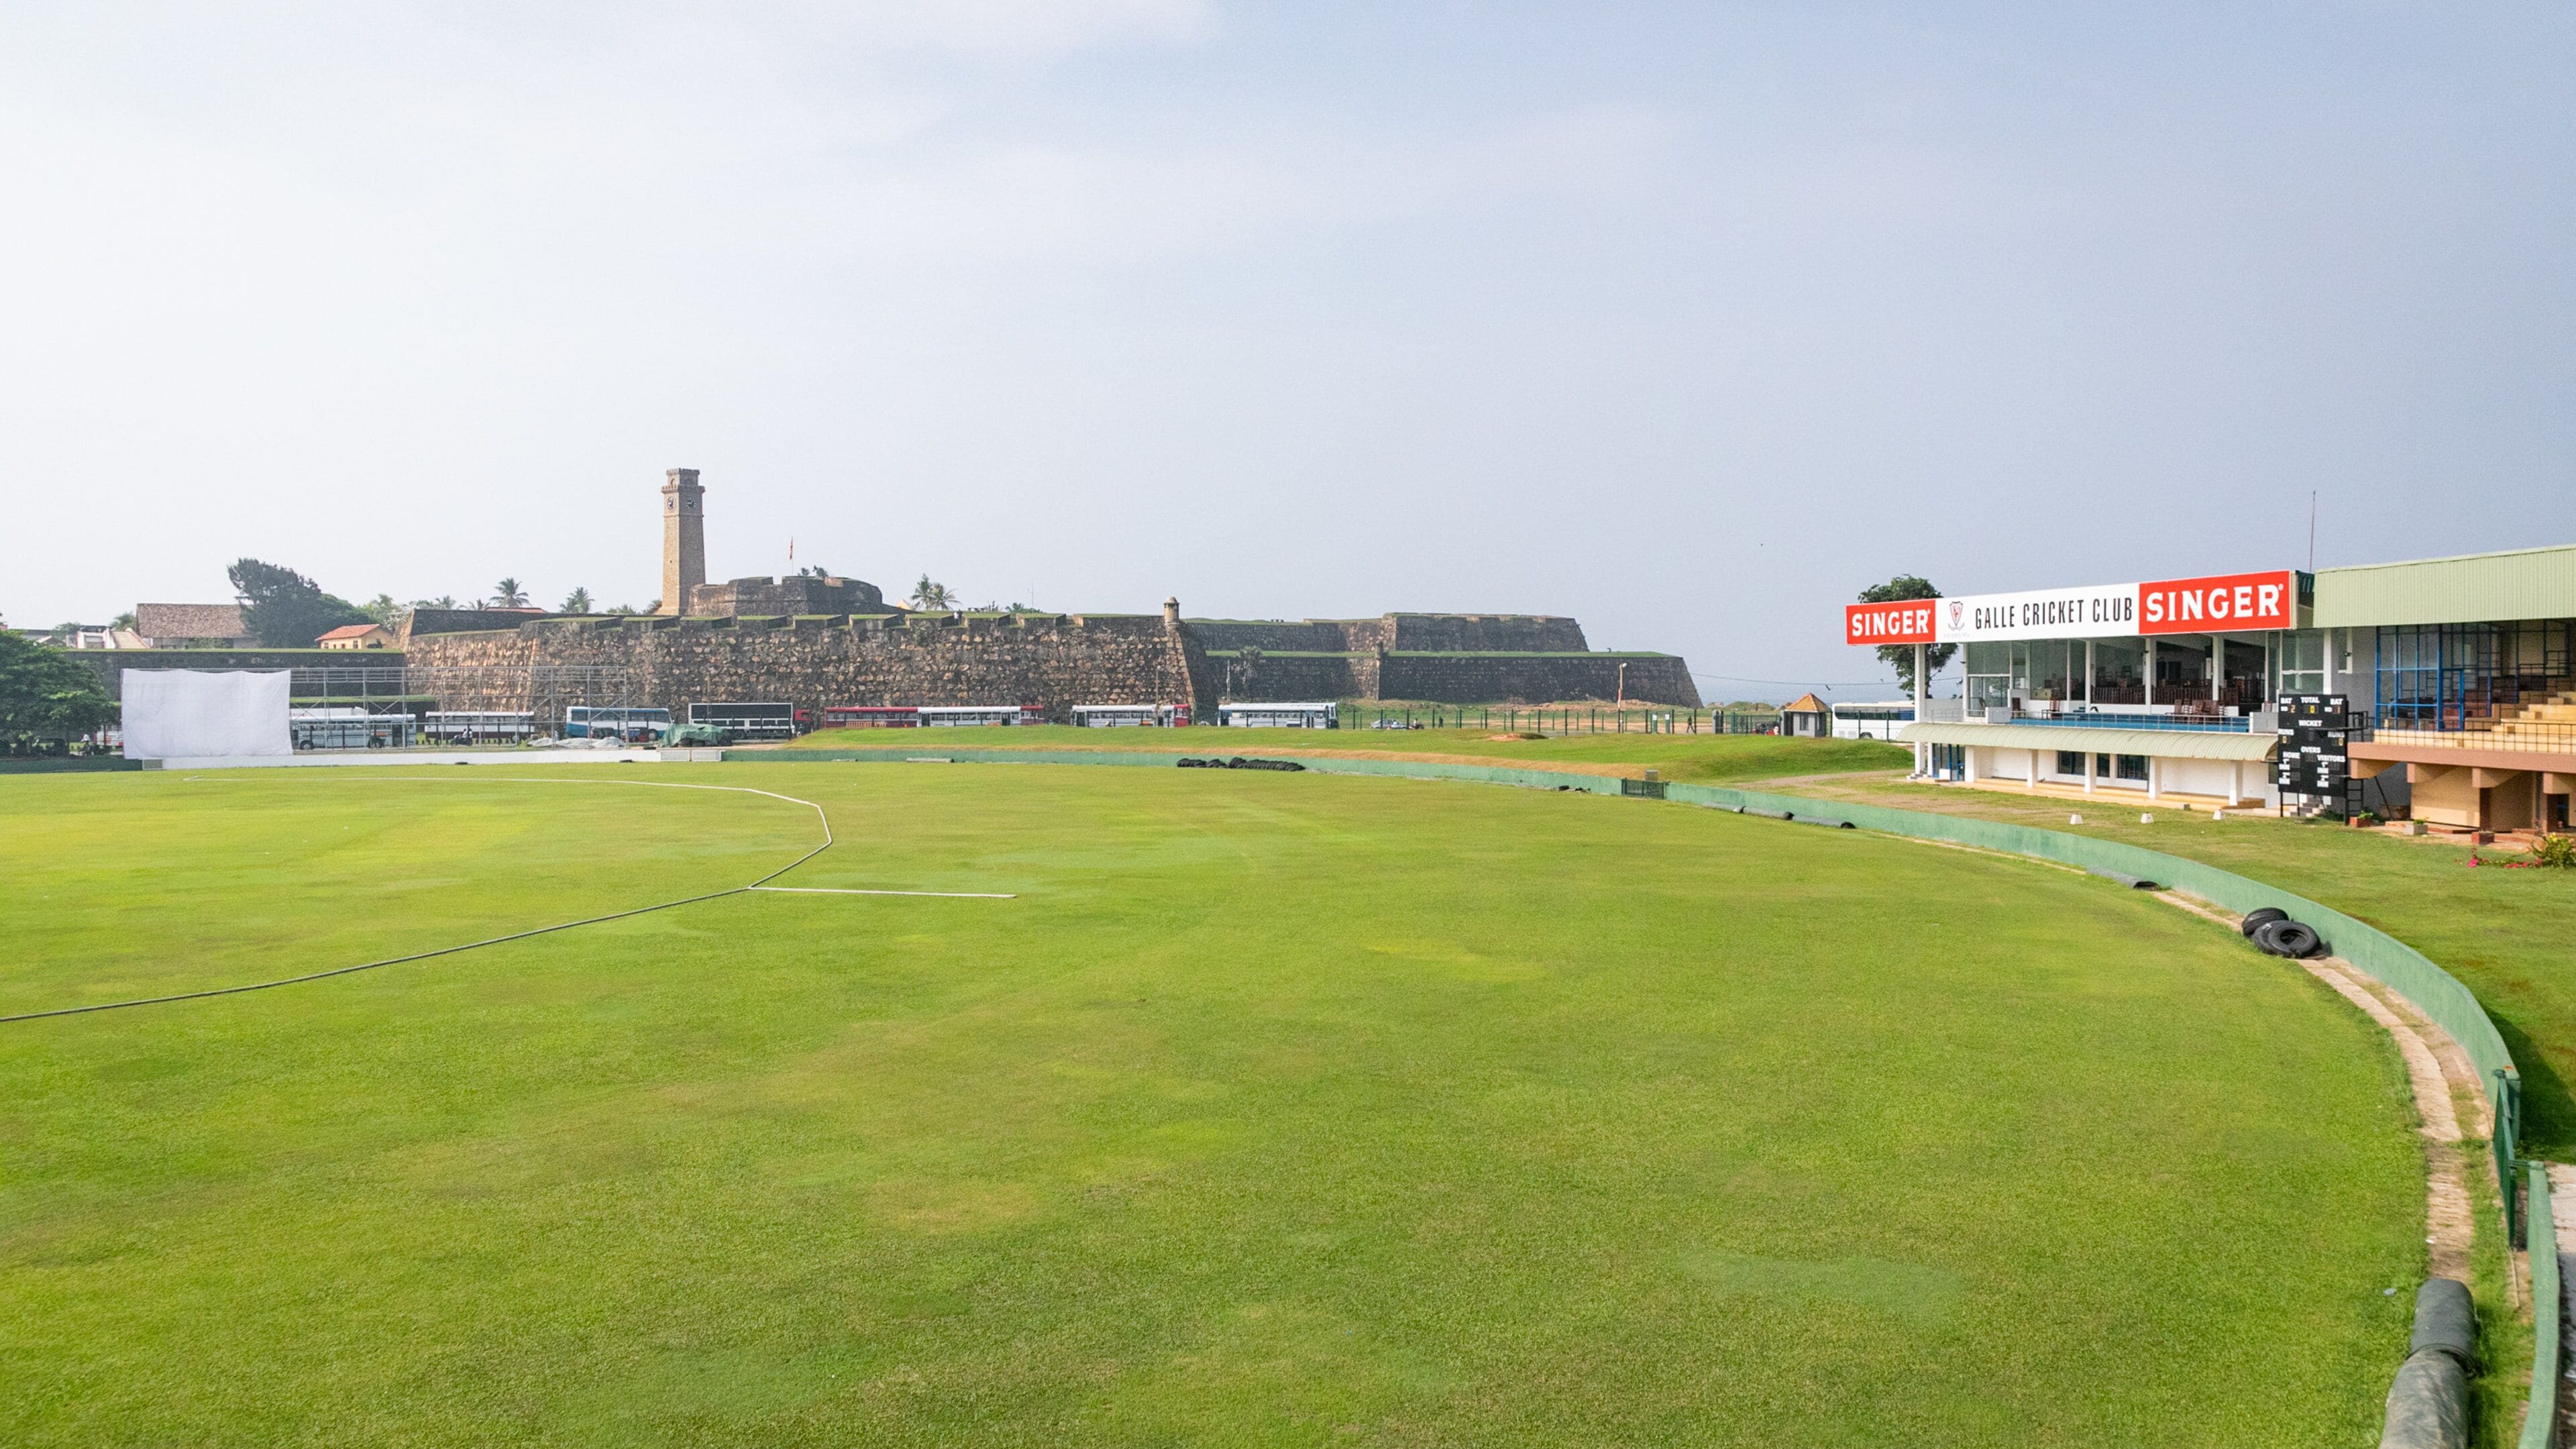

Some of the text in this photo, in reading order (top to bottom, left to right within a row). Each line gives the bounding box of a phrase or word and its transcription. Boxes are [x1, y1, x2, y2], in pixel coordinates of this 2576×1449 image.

[1975, 597, 2133, 629] GALLE CRICKET CLUB
[2146, 584, 2281, 623] SINGER
[1851, 609, 1929, 637] SINGER
[2317, 754, 2346, 763] VISITORS
